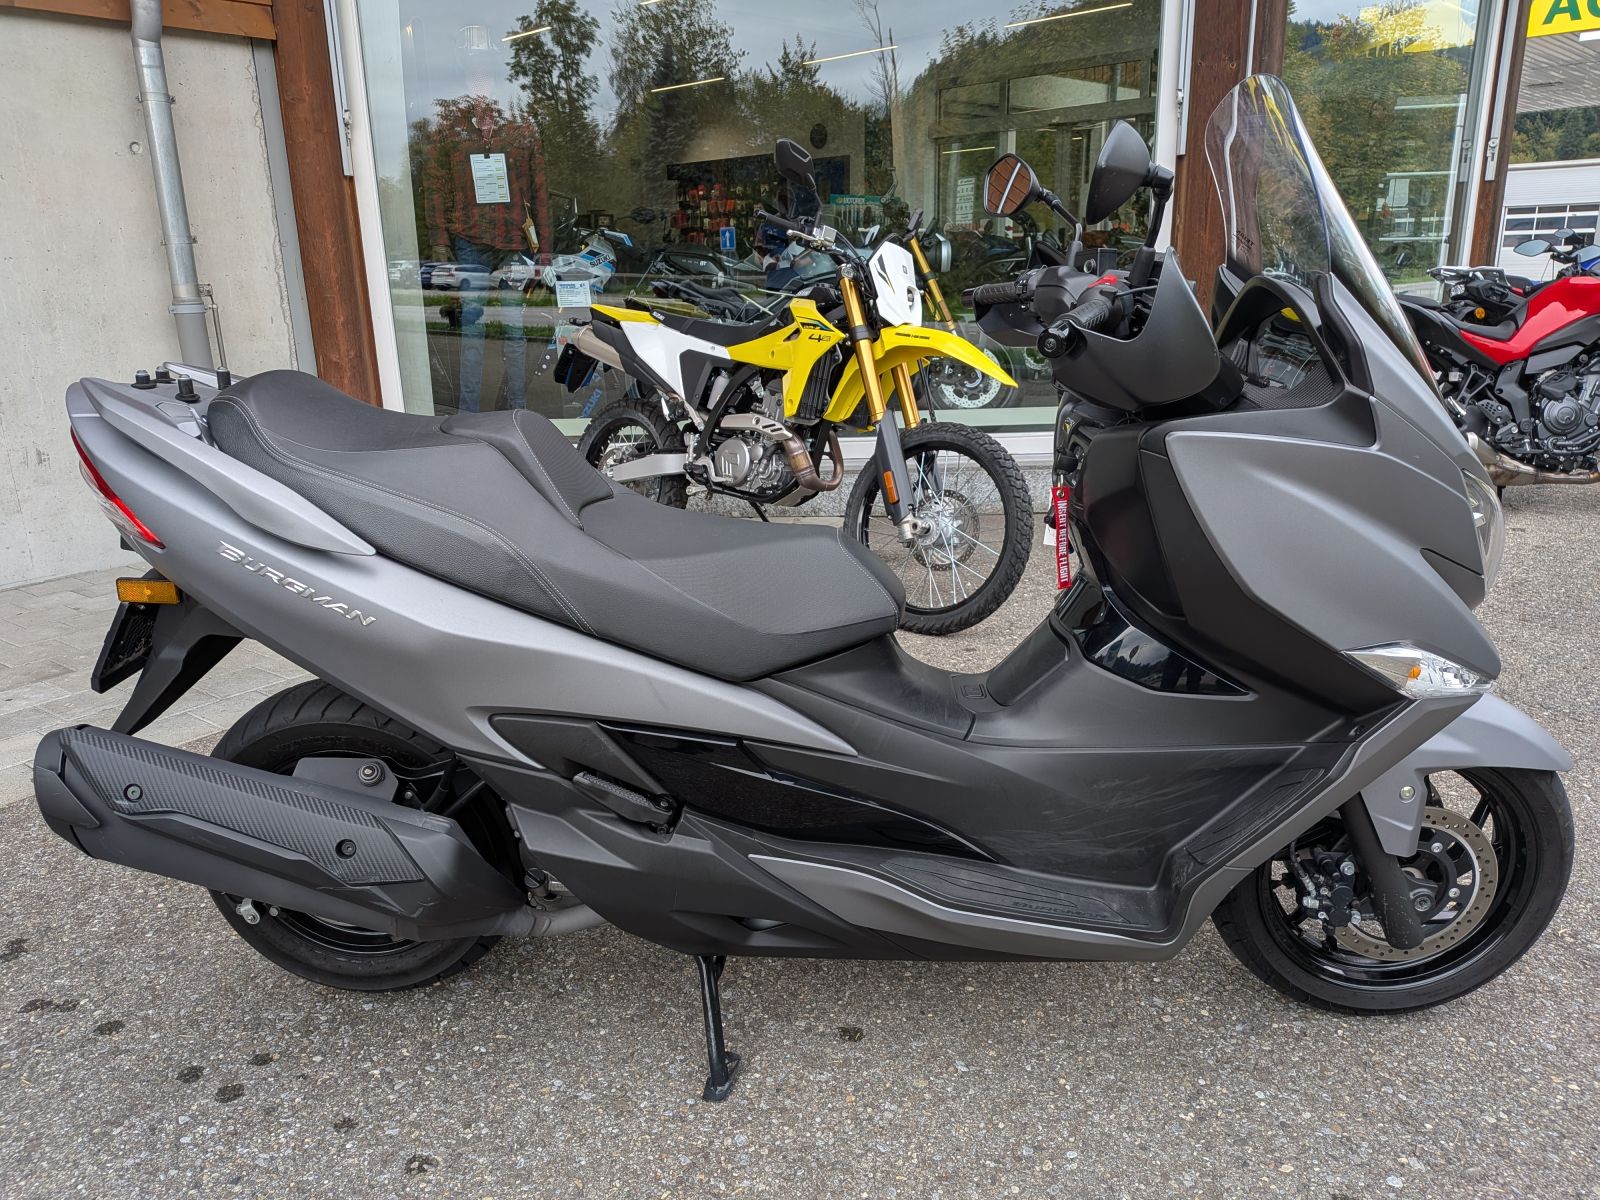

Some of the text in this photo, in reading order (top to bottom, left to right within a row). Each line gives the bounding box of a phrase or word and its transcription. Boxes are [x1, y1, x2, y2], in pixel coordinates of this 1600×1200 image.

[1541, 0, 1600, 25] A
[590, 254, 611, 267] SUZUKI
[581, 388, 603, 418] ZUKI
[1057, 500, 1069, 583] INSERT BEFORE FLIGHT
[216, 540, 377, 626] BURGMAN
